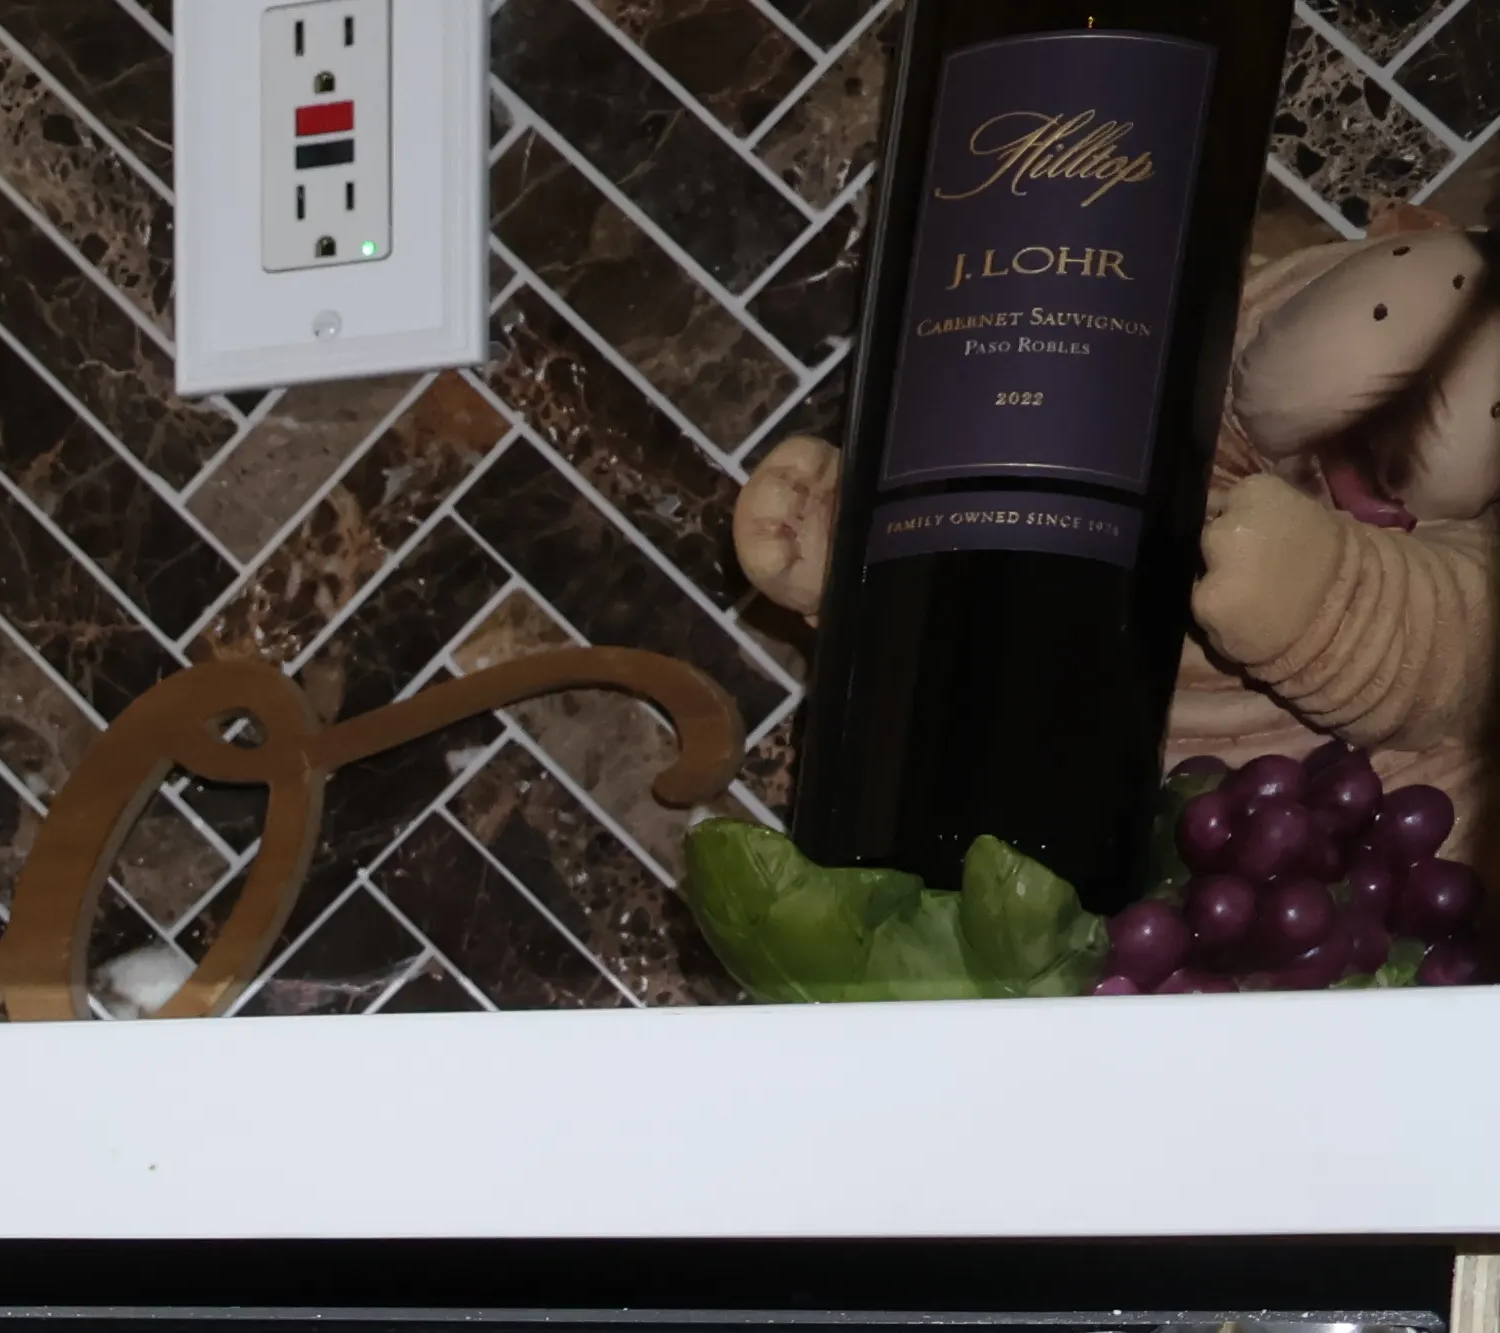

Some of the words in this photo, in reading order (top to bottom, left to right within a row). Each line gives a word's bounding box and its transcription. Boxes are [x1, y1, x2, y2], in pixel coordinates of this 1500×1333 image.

[934, 108, 1156, 207] Hilltop
[916, 311, 1023, 338] CABERNET
[1029, 307, 1153, 339] SAUVIGNON
[964, 339, 1012, 357] PASO
[1017, 336, 1091, 356] ROBLES
[994, 391, 1045, 407] 2022
[887, 513, 945, 535] FAMILY
[949, 510, 1020, 526] OWNED
[1025, 511, 1083, 530] SINCE
